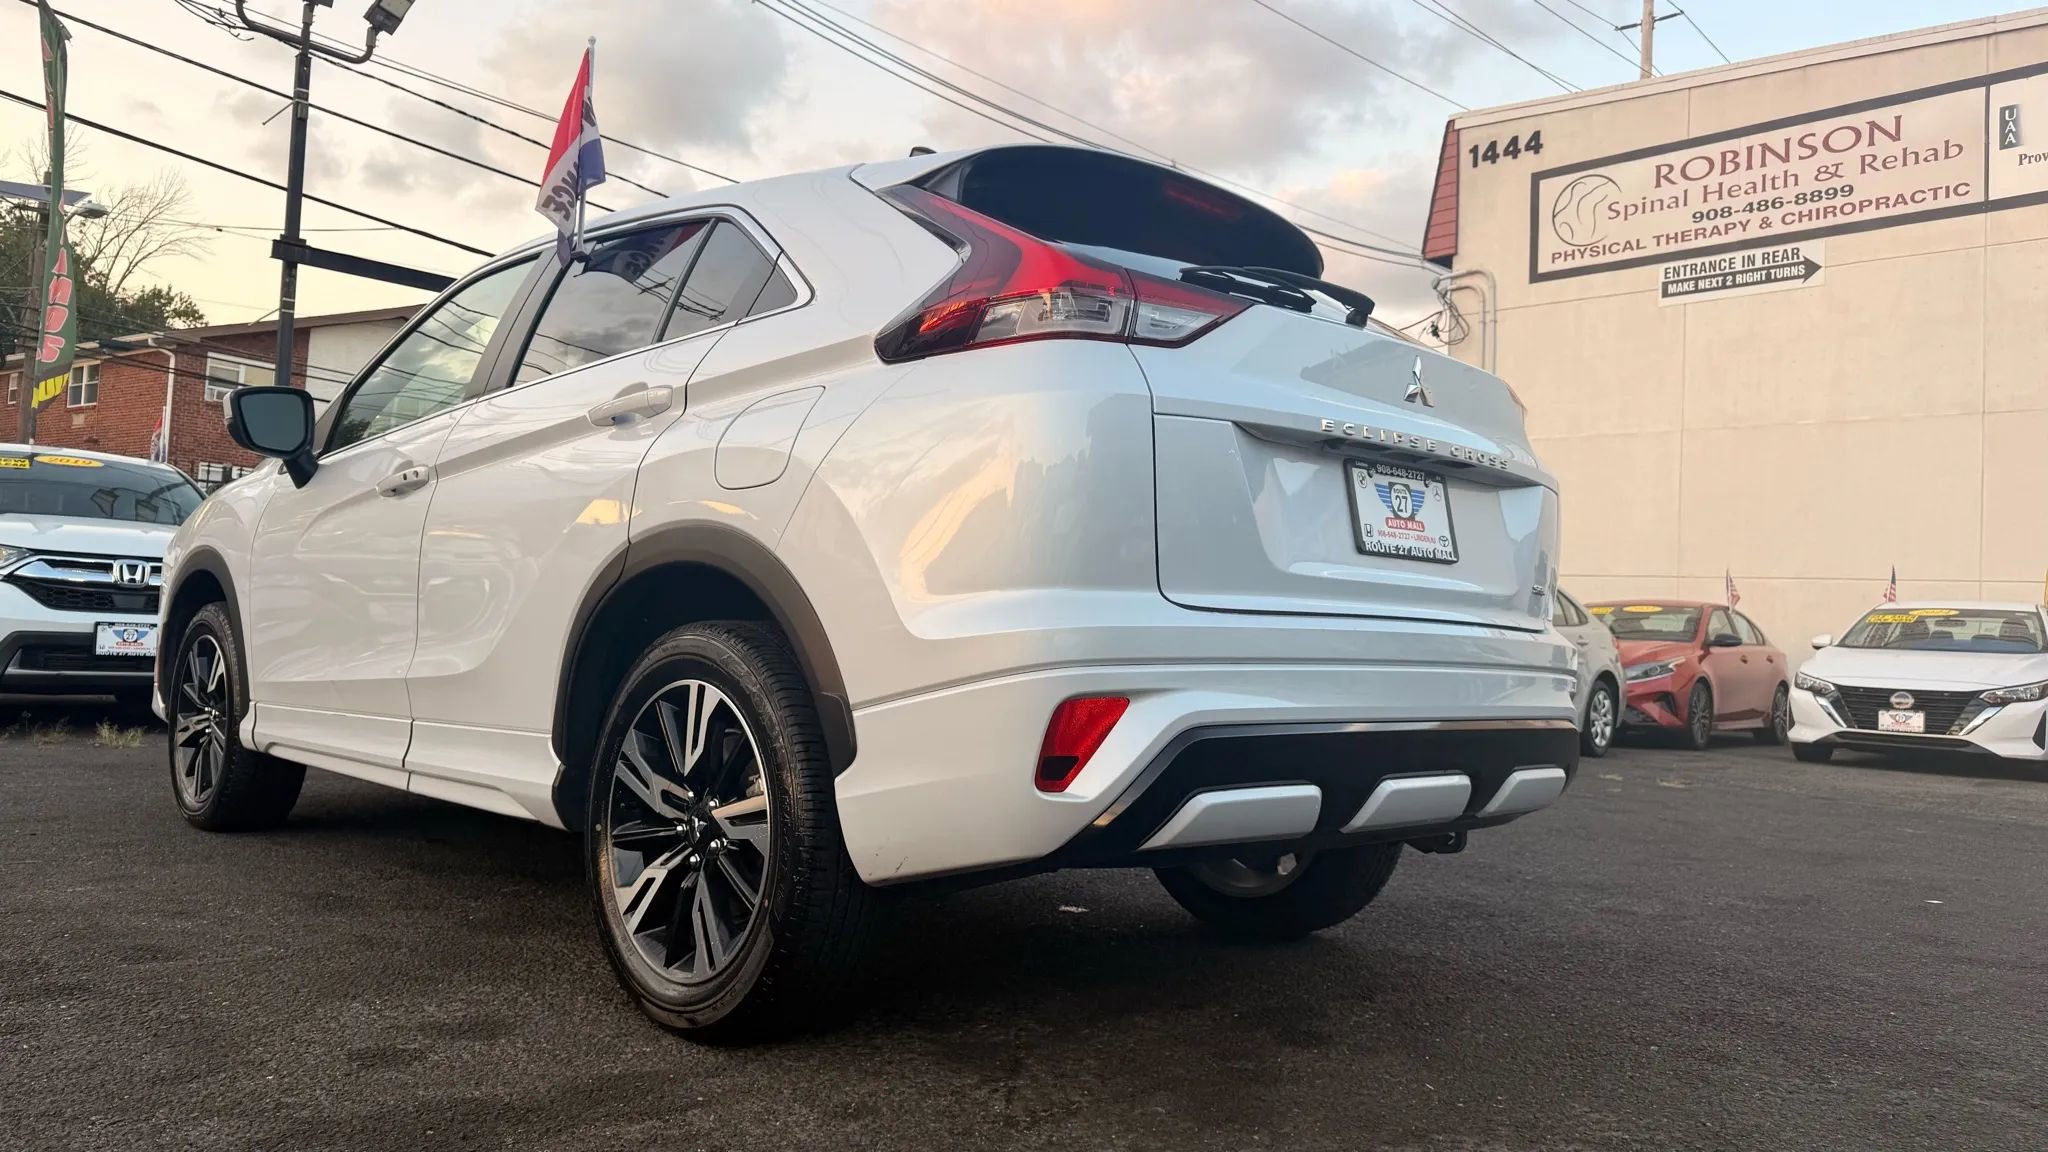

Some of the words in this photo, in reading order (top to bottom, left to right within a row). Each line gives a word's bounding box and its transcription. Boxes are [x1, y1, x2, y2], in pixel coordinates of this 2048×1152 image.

[1469, 130, 1544, 168] 1444
[1654, 115, 1903, 188] ROBINSON
[1607, 189, 1689, 221] Spinal
[1703, 169, 1799, 203] Health
[1814, 162, 1844, 182] &
[1860, 139, 1964, 174] Rehab
[1692, 184, 1855, 223] 908-486-8899
[1551, 239, 1647, 264] PHYSICAL
[1652, 219, 1752, 247] THERAPY
[1758, 216, 1773, 230] &
[1781, 182, 1972, 225] CHIROPRACTIC
[1664, 256, 1737, 280] ENTRANCE
[1742, 253, 1756, 268] IN
[1762, 247, 1801, 266] REAR
[1667, 280, 1696, 295] MAKE
[1698, 277, 1724, 290] NEXT
[1726, 276, 1733, 286] 2
[1735, 270, 1767, 285] RIGHT
[1769, 264, 1806, 280] TURNS
[1320, 418, 1438, 452] ECLIPSE
[1450, 446, 1510, 470] CROSS
[1395, 495, 1408, 514] 27
[1388, 519, 1406, 529] AUTO
[1407, 521, 1424, 531] MALL
[1365, 540, 1397, 554] ROUTE
[1398, 544, 1409, 555] 27
[1411, 546, 1433, 558] AUTO
[1435, 548, 1457, 561] MALL
[126, 632, 135, 640] 27
